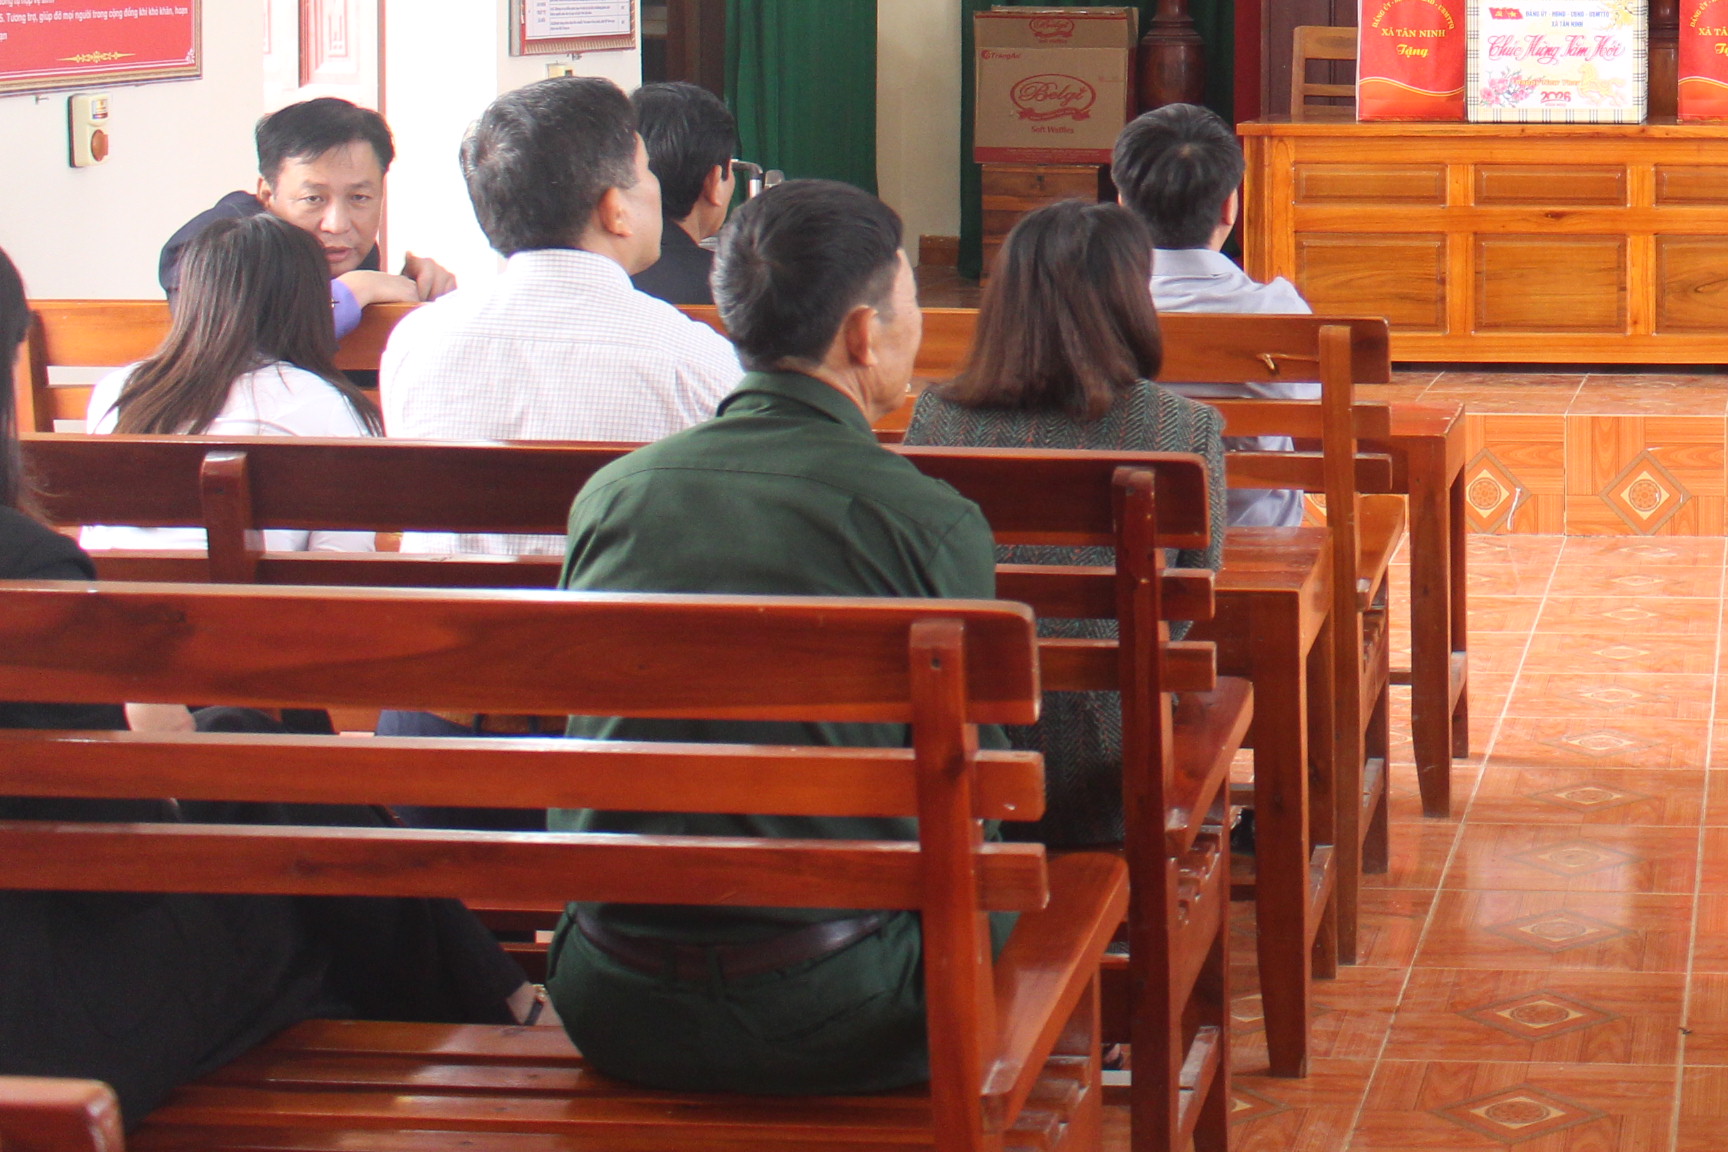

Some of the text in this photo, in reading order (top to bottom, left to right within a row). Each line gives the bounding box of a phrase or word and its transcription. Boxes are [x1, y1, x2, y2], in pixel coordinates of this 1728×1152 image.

[1381, 27, 1446, 37] XÃ TÂN NINH
[1698, 26, 1712, 36] XÃ
[1396, 43, 1428, 58] Tặng
[1488, 34, 1625, 65] Chúc Mừng Năm Mới
[1540, 91, 1571, 103] 2026
